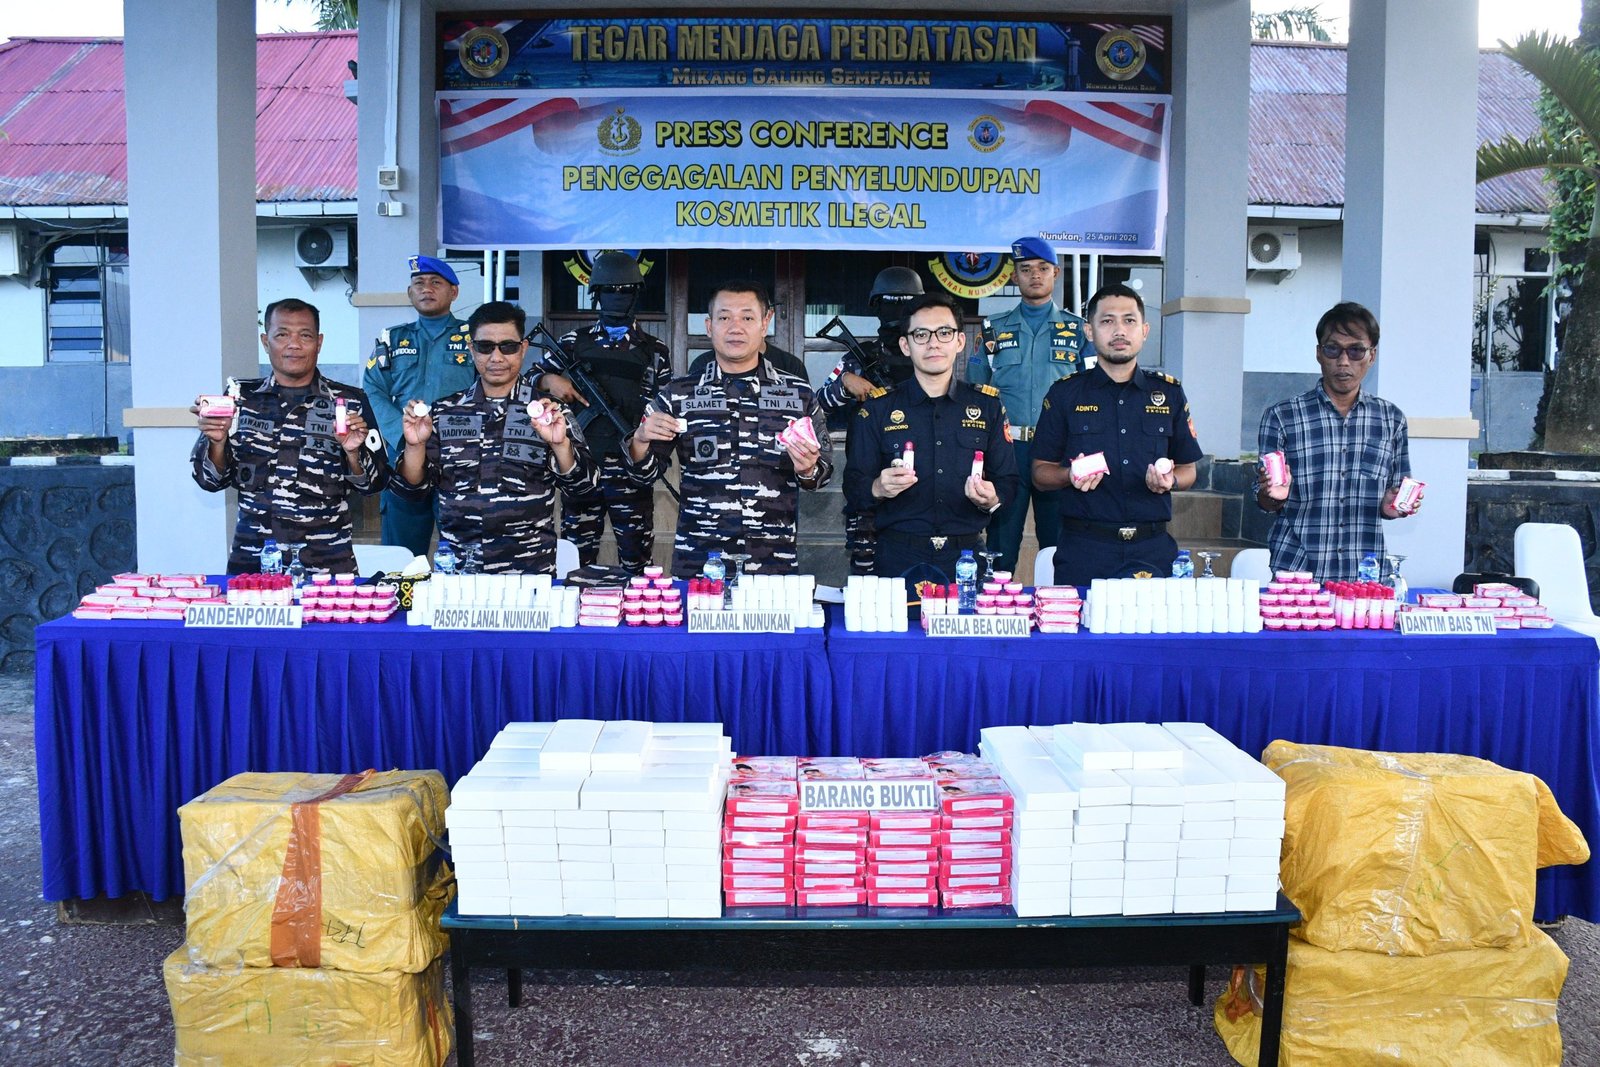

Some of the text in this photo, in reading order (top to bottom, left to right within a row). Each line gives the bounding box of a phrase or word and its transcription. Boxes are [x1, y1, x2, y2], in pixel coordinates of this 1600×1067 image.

[567, 25, 1037, 63] TEGAR MENJAGA PERBATASAN
[656, 121, 742, 148] PRESS
[749, 121, 948, 149] CONFERENCE
[562, 164, 1040, 194] PENGGAGALAN PENYELUNDUPAN
[676, 201, 926, 229] KOSMETIK ILEGAL
[1039, 231, 1082, 242] Nunukan,
[1098, 233, 1117, 241] April
[938, 272, 1008, 296] LANAL NUNUKAN
[1053, 338, 1078, 348] TNI AL
[685, 400, 722, 409] SLAMET
[764, 400, 798, 409] TNI AL
[310, 423, 328, 432] TNI
[507, 428, 526, 437] TNI
[187, 607, 294, 626] DANDENPOMAL
[433, 609, 549, 629] PASOPS LANAL NUNUKAN
[690, 613, 791, 631] DANLANAL NUNUKAN
[1405, 615, 1494, 632] DANTIM BAIS TNI
[931, 618, 1027, 636] KEPALA BEA CUKAI
[804, 785, 875, 808] BARANG
[880, 785, 931, 808] BUKTI
